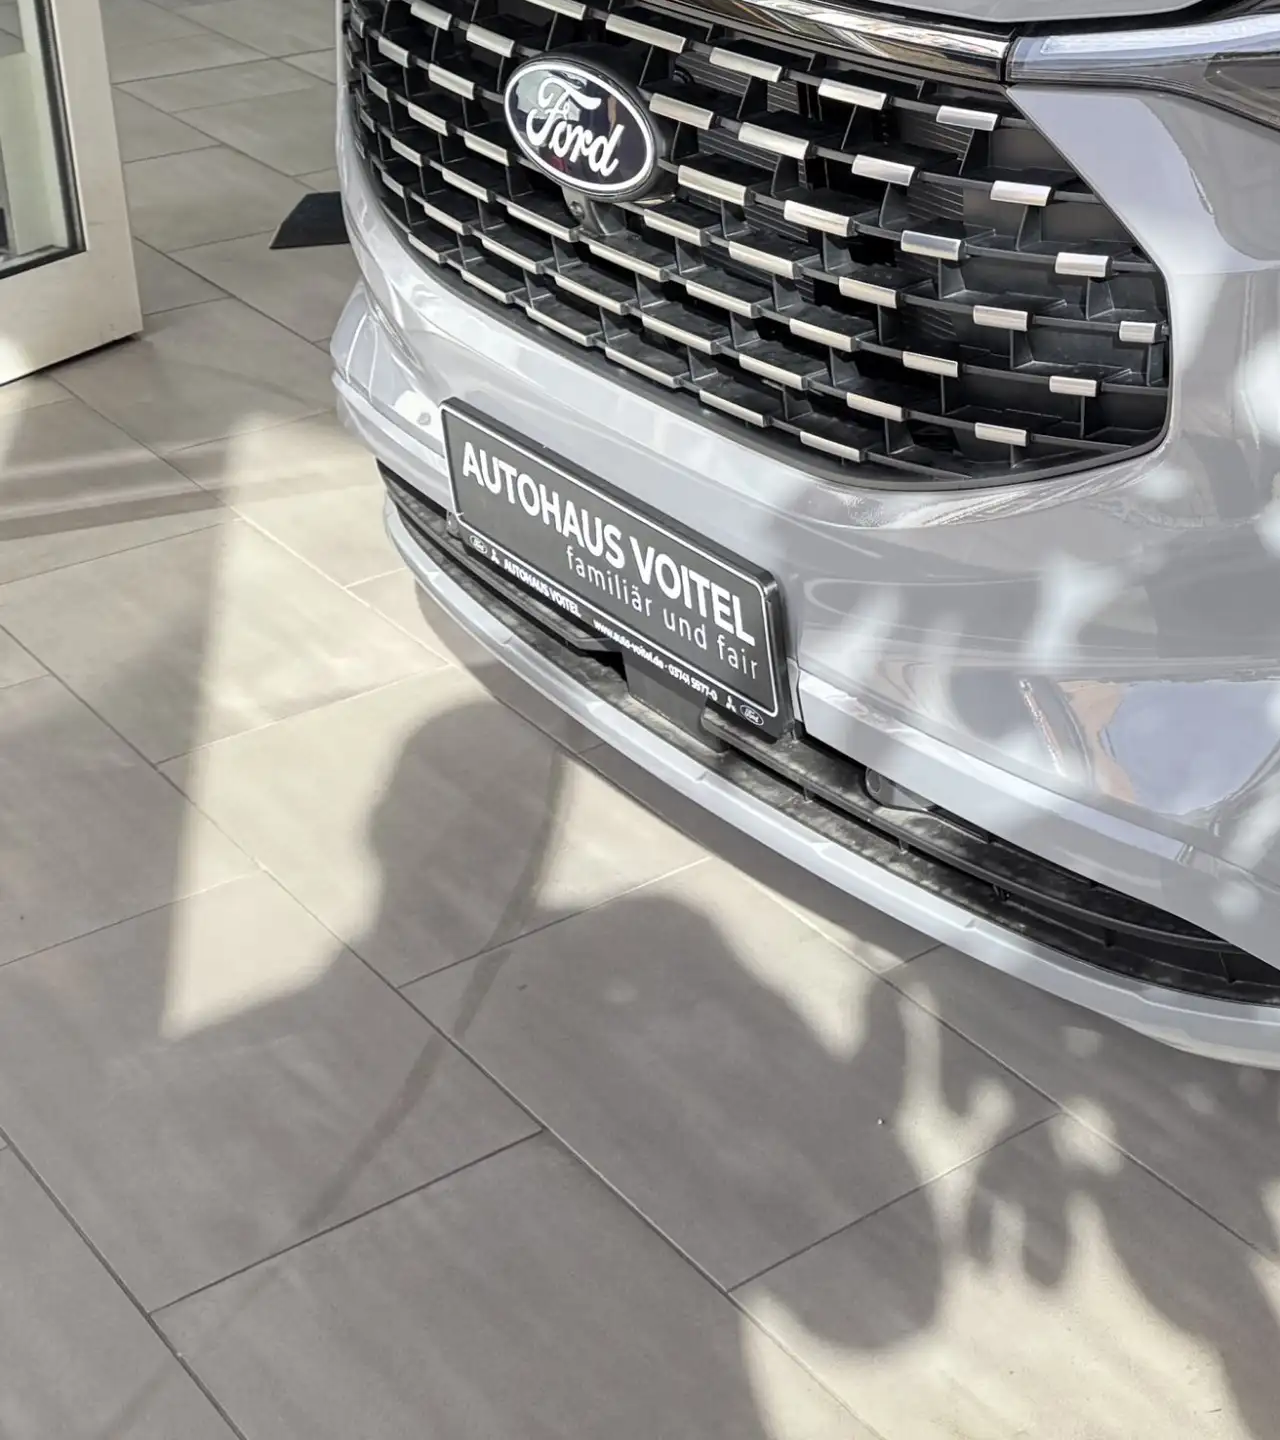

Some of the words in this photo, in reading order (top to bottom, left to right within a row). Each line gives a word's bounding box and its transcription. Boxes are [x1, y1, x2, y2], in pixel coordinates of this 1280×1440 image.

[526, 76, 625, 177] Ford
[462, 441, 626, 570] AUTOHAUS
[629, 536, 756, 647] VOITEL
[566, 545, 653, 617] familiär
[663, 609, 707, 650] und
[716, 634, 759, 680] fair
